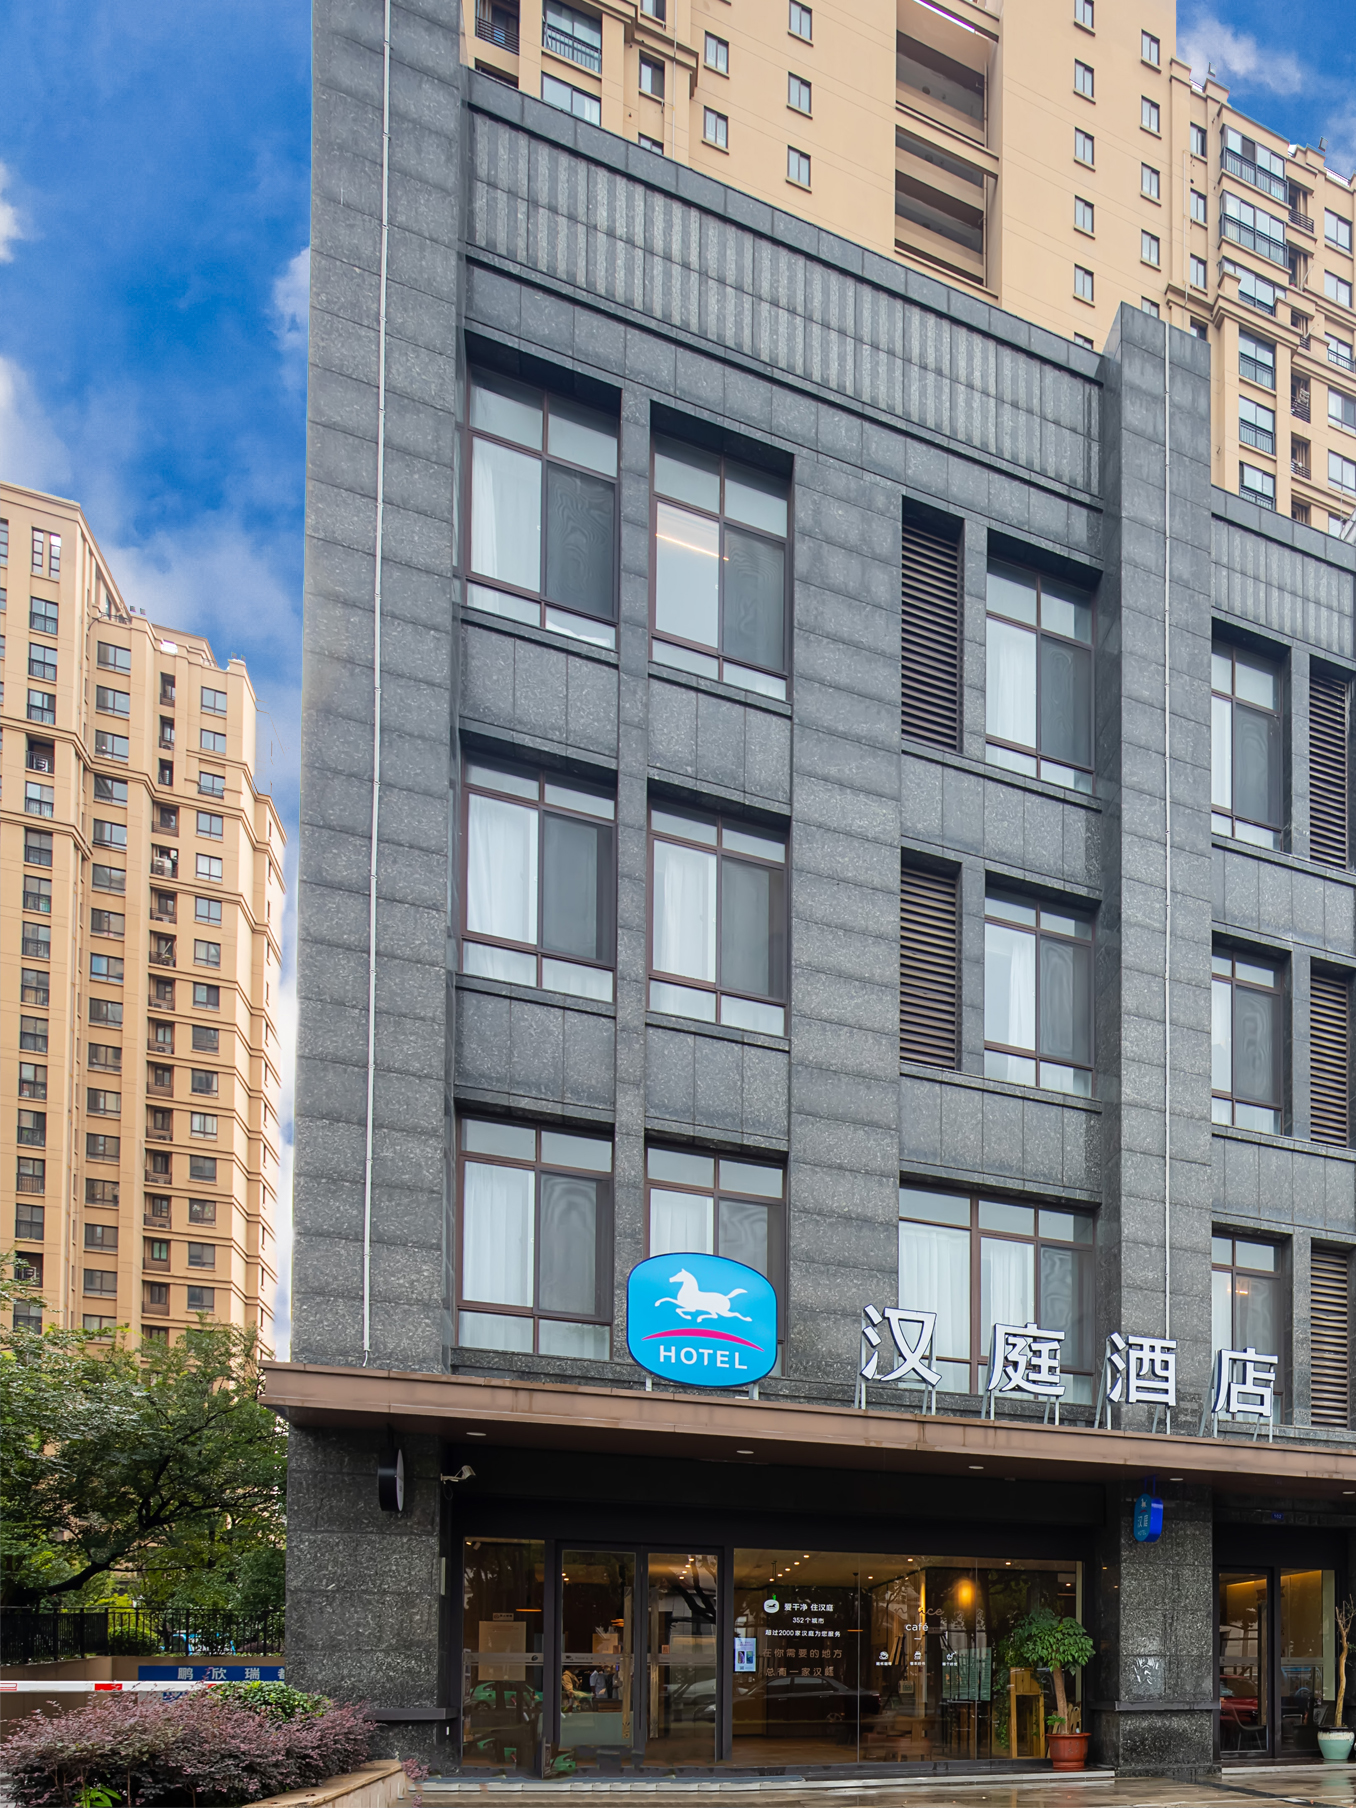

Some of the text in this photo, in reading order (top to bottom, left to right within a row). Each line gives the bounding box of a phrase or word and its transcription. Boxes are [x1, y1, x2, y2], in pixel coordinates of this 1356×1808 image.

[659, 1344, 748, 1370] HOTEL
[859, 1302, 1280, 1418] 汉庭酒店
[784, 1602, 834, 1612] 爱干净 住汉庭
[905, 1622, 929, 1632] café
[762, 1648, 843, 1659] 在你需要的地方
